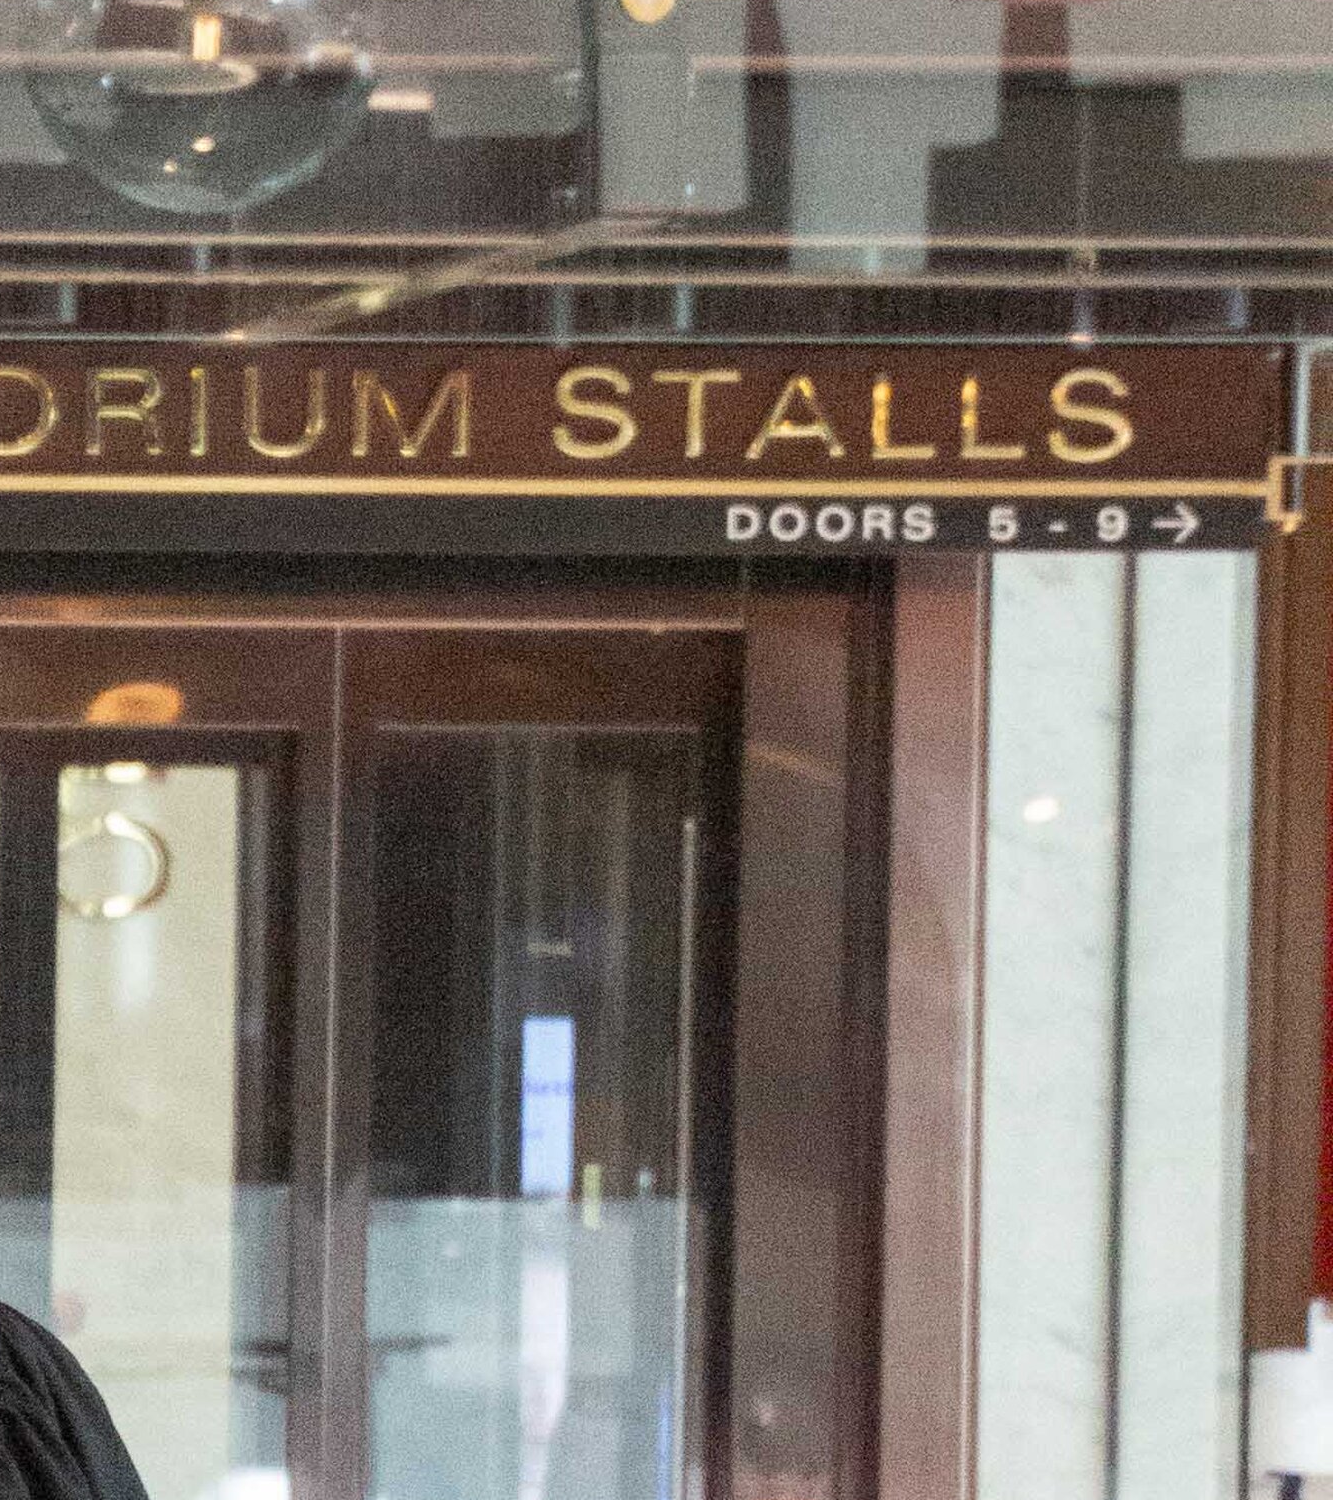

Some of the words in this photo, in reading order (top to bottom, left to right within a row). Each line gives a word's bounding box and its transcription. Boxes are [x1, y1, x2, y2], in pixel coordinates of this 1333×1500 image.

[552, 368, 1135, 464] STALLS
[726, 503, 935, 542] DOORS
[989, 505, 1019, 542] 5
[1096, 505, 1129, 542] 9
